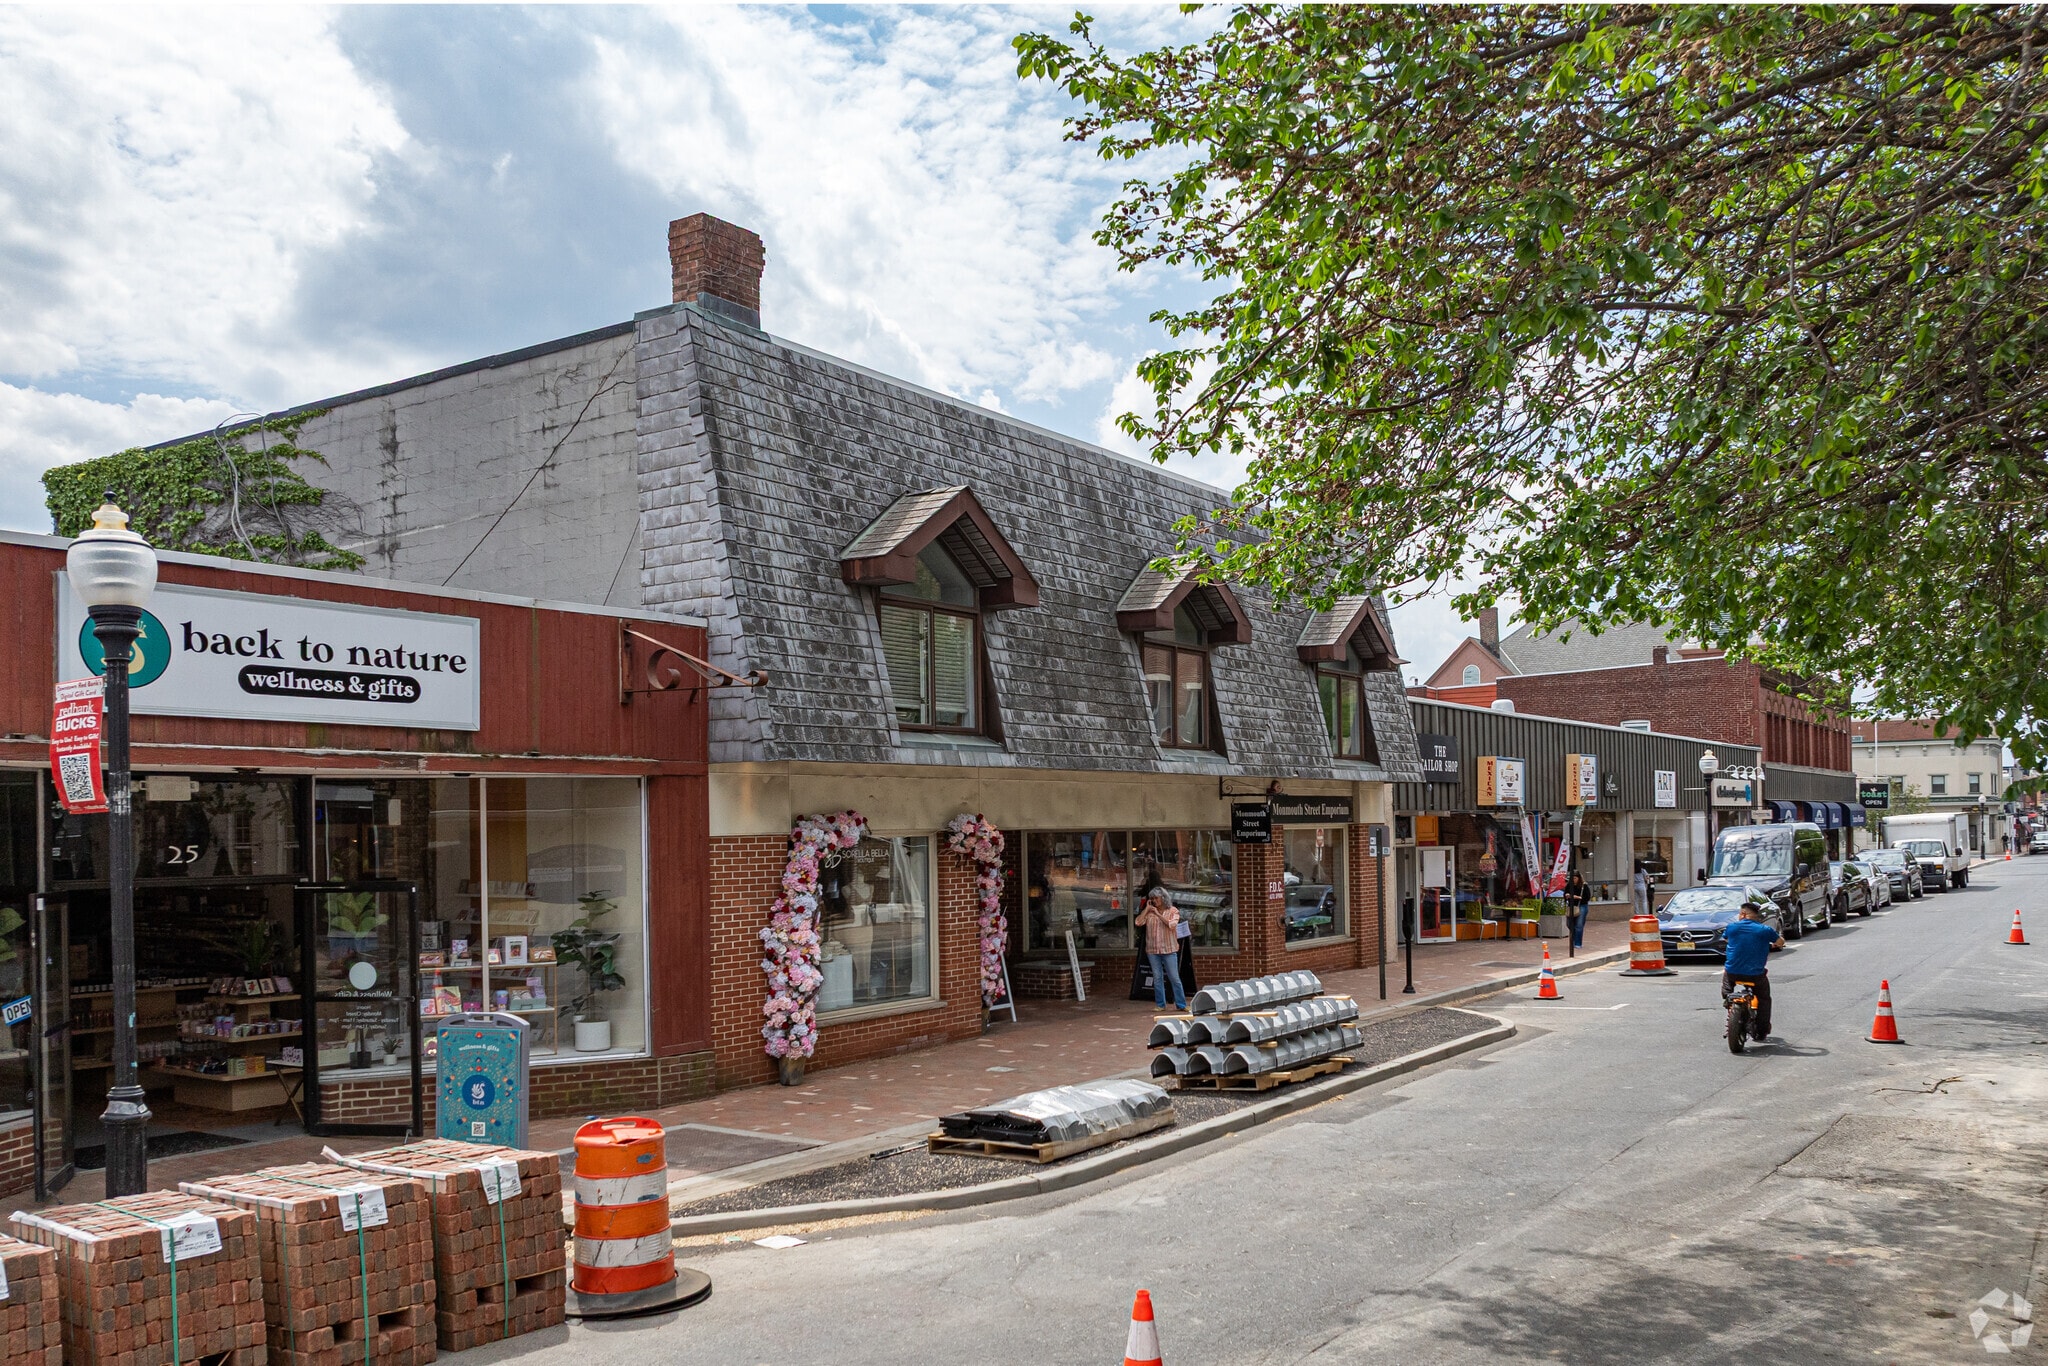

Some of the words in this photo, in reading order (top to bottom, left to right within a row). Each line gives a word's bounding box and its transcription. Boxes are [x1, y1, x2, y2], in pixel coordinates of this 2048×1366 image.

[180, 621, 285, 659] back
[297, 635, 334, 663] to
[346, 644, 468, 674] nature
[246, 670, 345, 693] wellness
[348, 675, 365, 694] &
[368, 677, 415, 700] gifts
[61, 693, 73, 701] Digital
[59, 701, 94, 716] redbank
[56, 716, 96, 733] BUCKS
[1433, 745, 1447, 758] THE
[1421, 759, 1443, 772] AILOR
[1444, 760, 1458, 773] SHOP
[1486, 760, 1494, 797] MEXICAN
[1658, 774, 1672, 790] ART
[1861, 790, 1888, 798] toast
[1272, 803, 1303, 816] Monmouth
[1304, 804, 1321, 816] Street
[1321, 803, 1349, 818] Emporium
[1236, 830, 1267, 838] Emporium
[167, 845, 199, 864] 25
[842, 849, 870, 859] SORELLA
[871, 848, 890, 857] BELLA
[6, 1000, 32, 1021] OPEN
